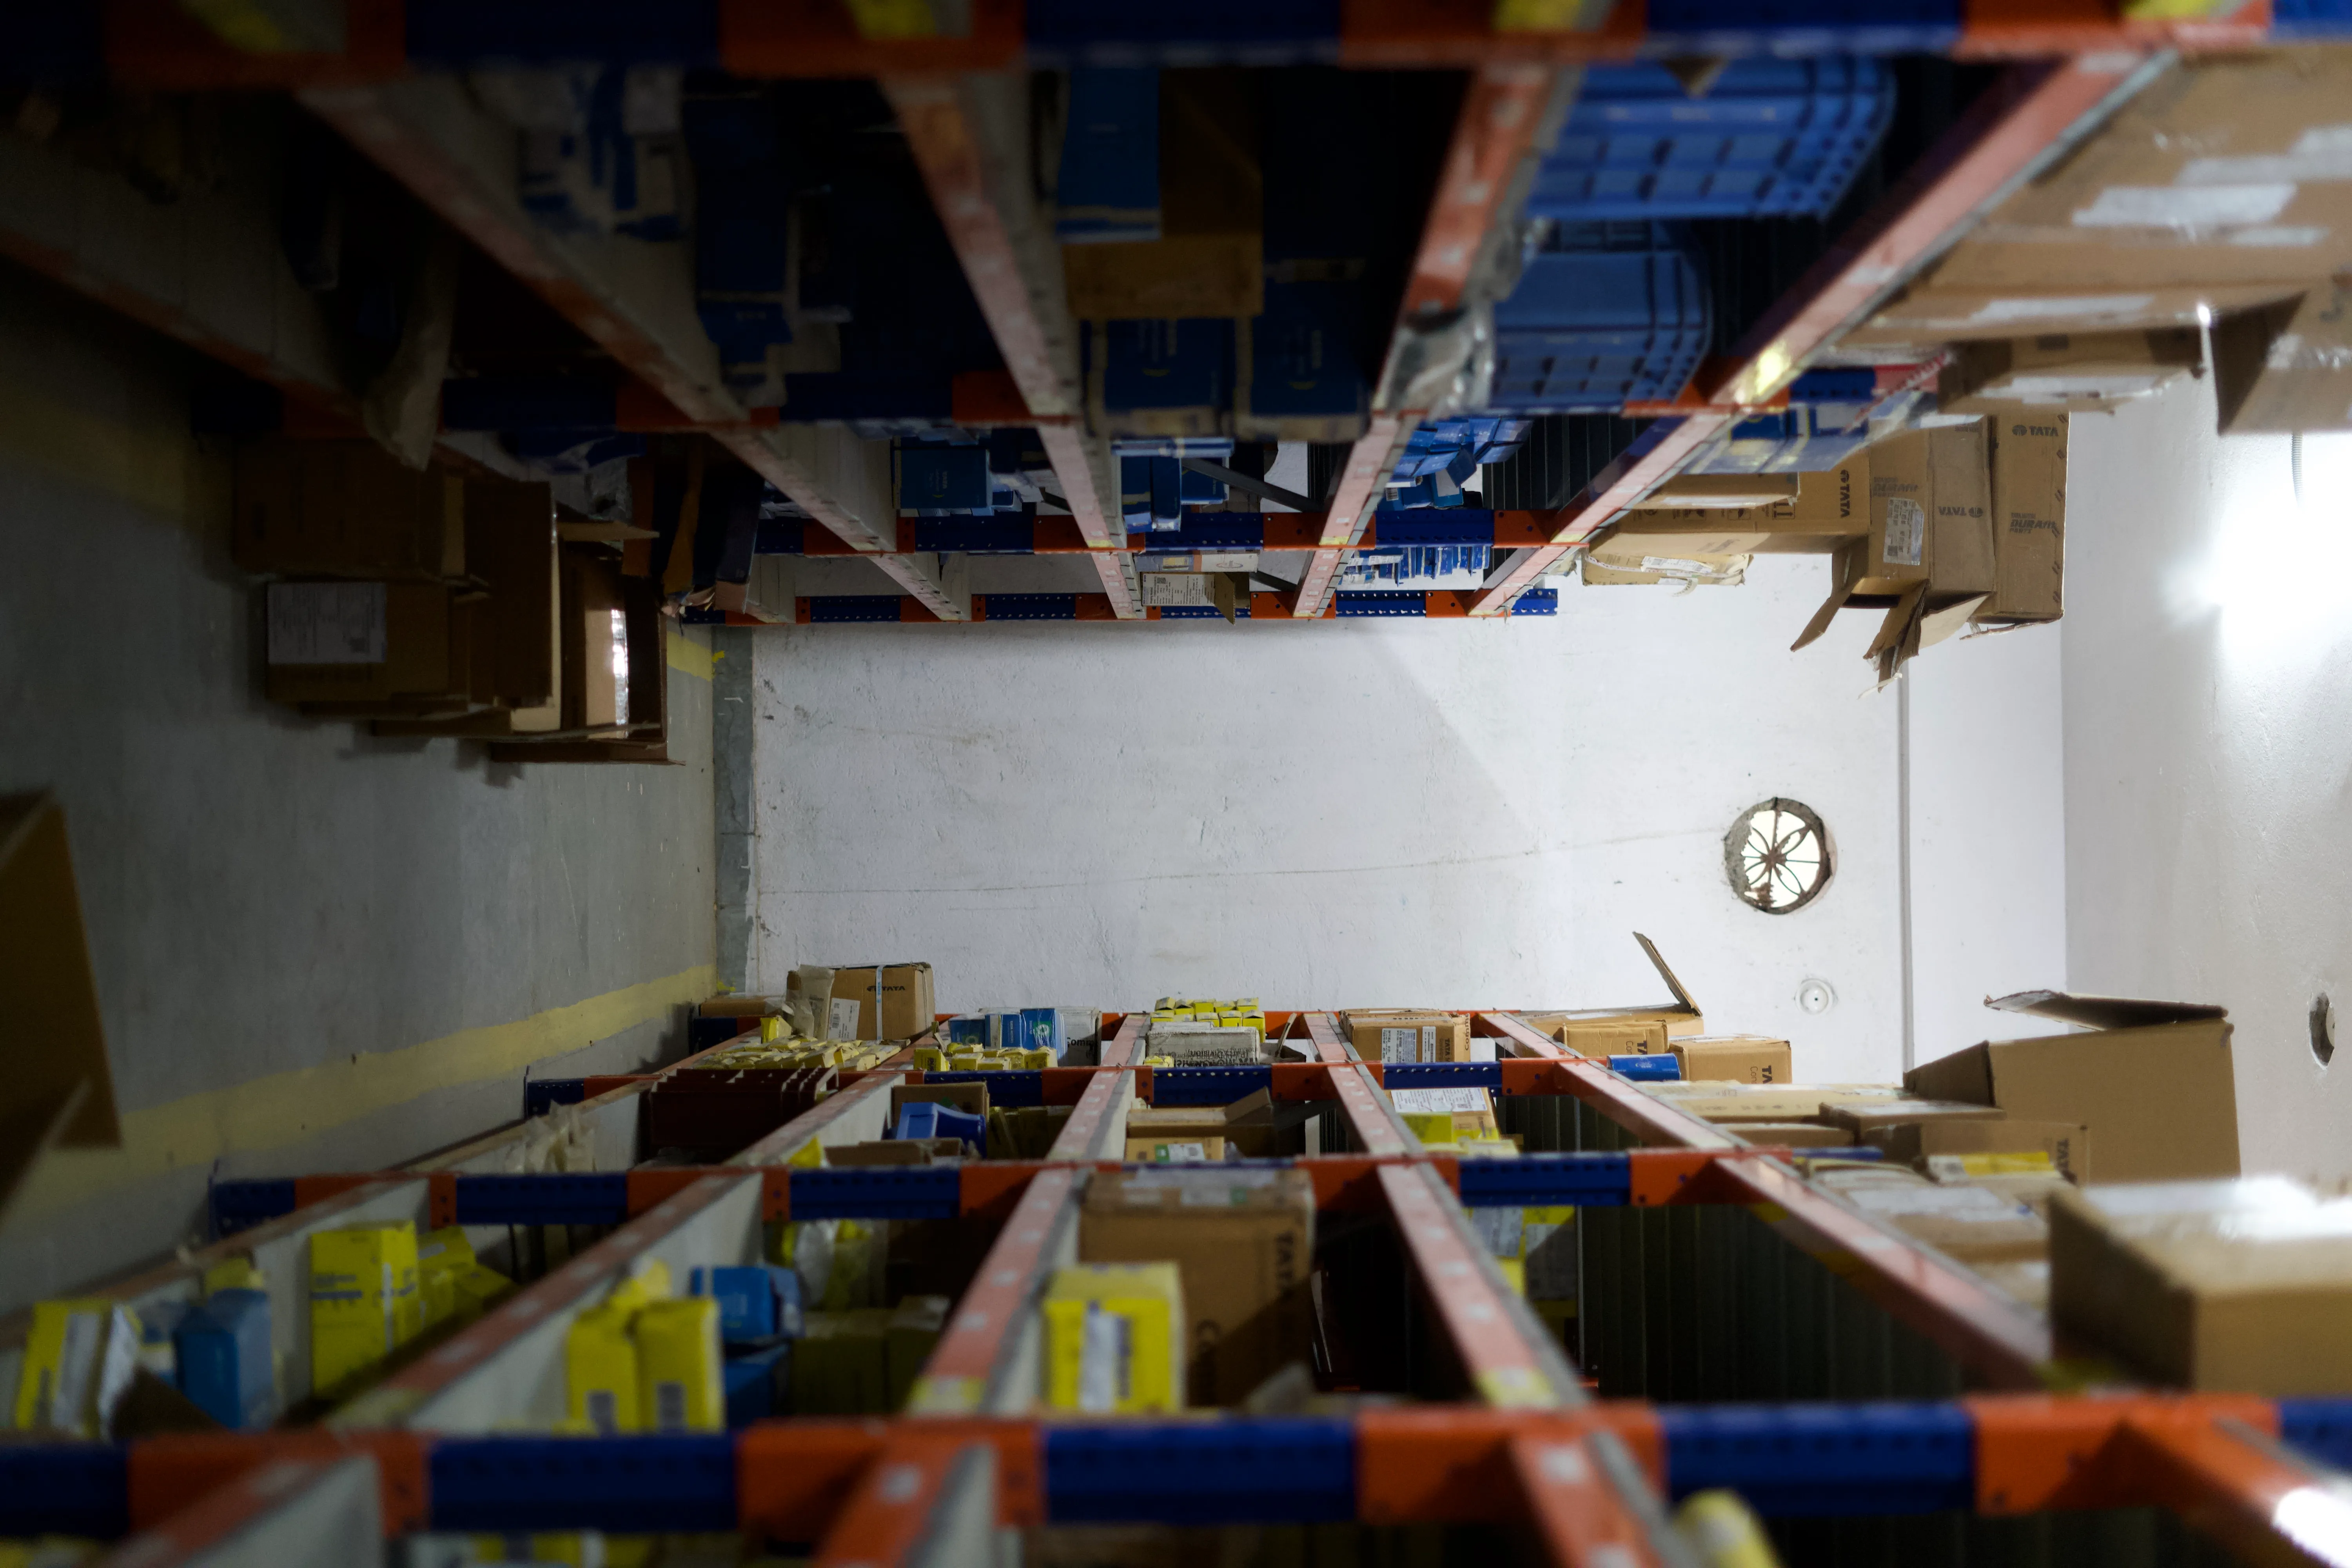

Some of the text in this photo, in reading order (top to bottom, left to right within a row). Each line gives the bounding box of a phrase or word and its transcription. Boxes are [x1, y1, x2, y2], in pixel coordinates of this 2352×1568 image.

[2029, 425, 2059, 436] TATA
[1840, 484, 1850, 518] TATA
[1938, 506, 1967, 516] TATA
